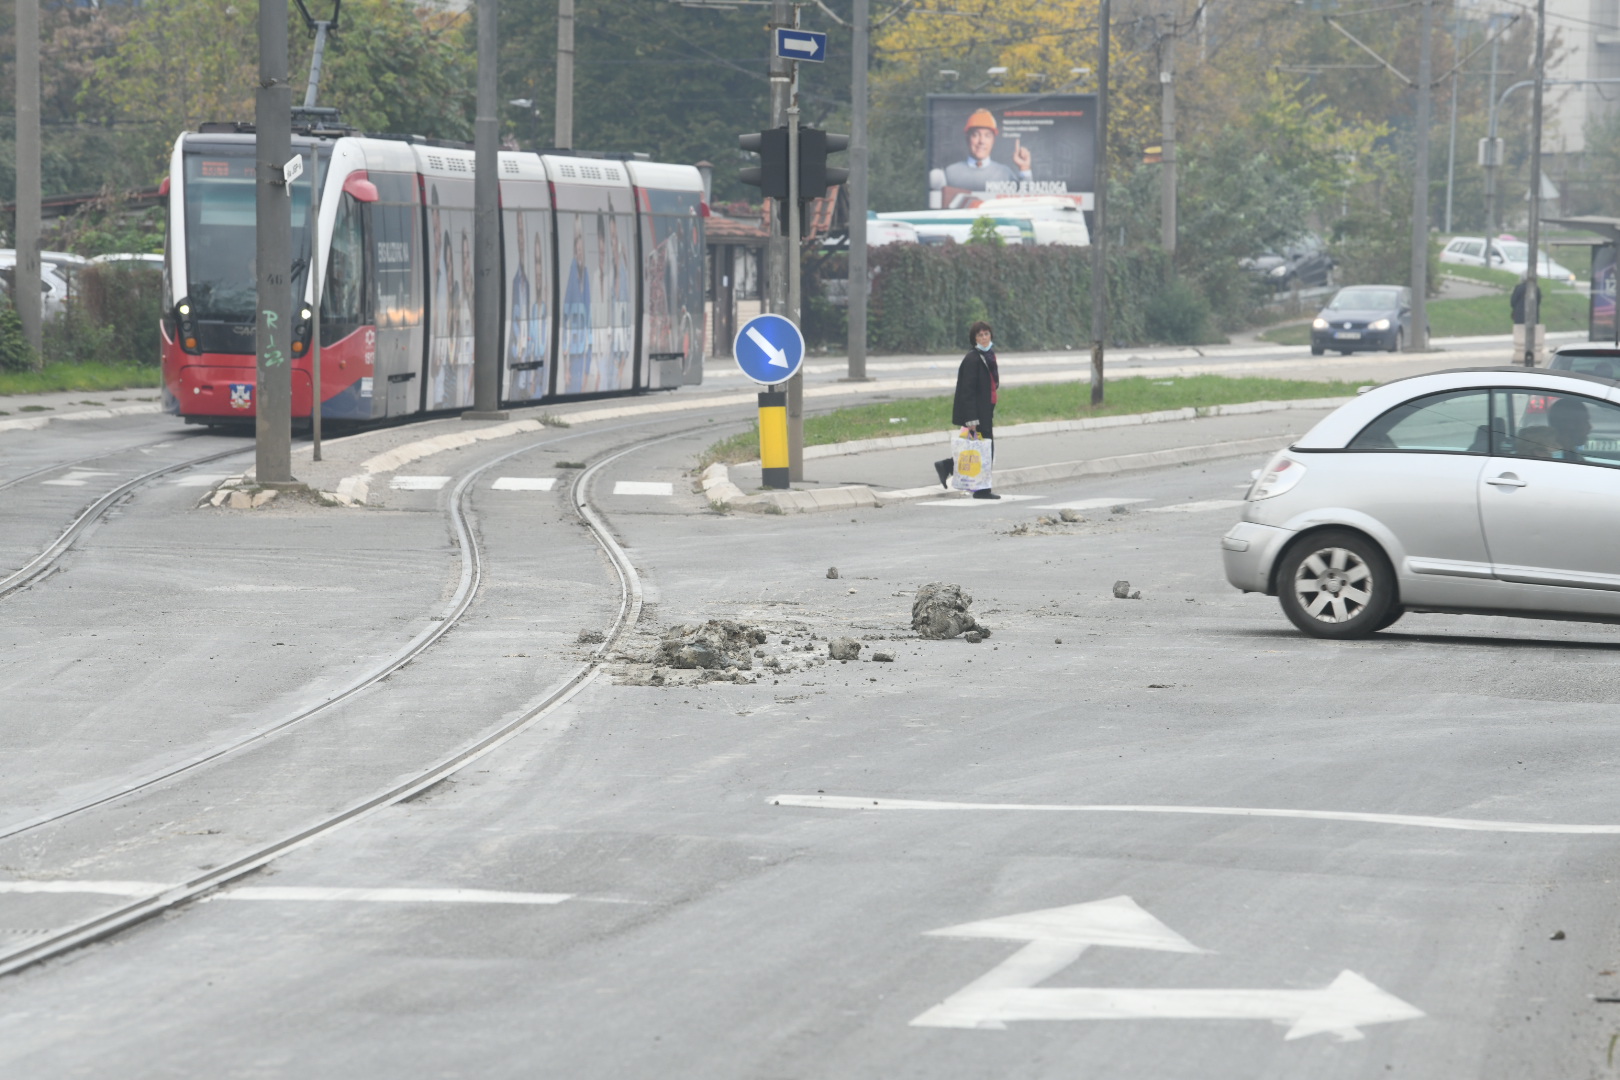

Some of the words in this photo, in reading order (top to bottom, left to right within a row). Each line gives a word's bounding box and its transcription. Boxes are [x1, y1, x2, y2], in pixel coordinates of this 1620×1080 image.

[985, 181, 1018, 193] MNOGO
[1019, 181, 1029, 193] JE
[1029, 181, 1068, 193] RAZLOGA
